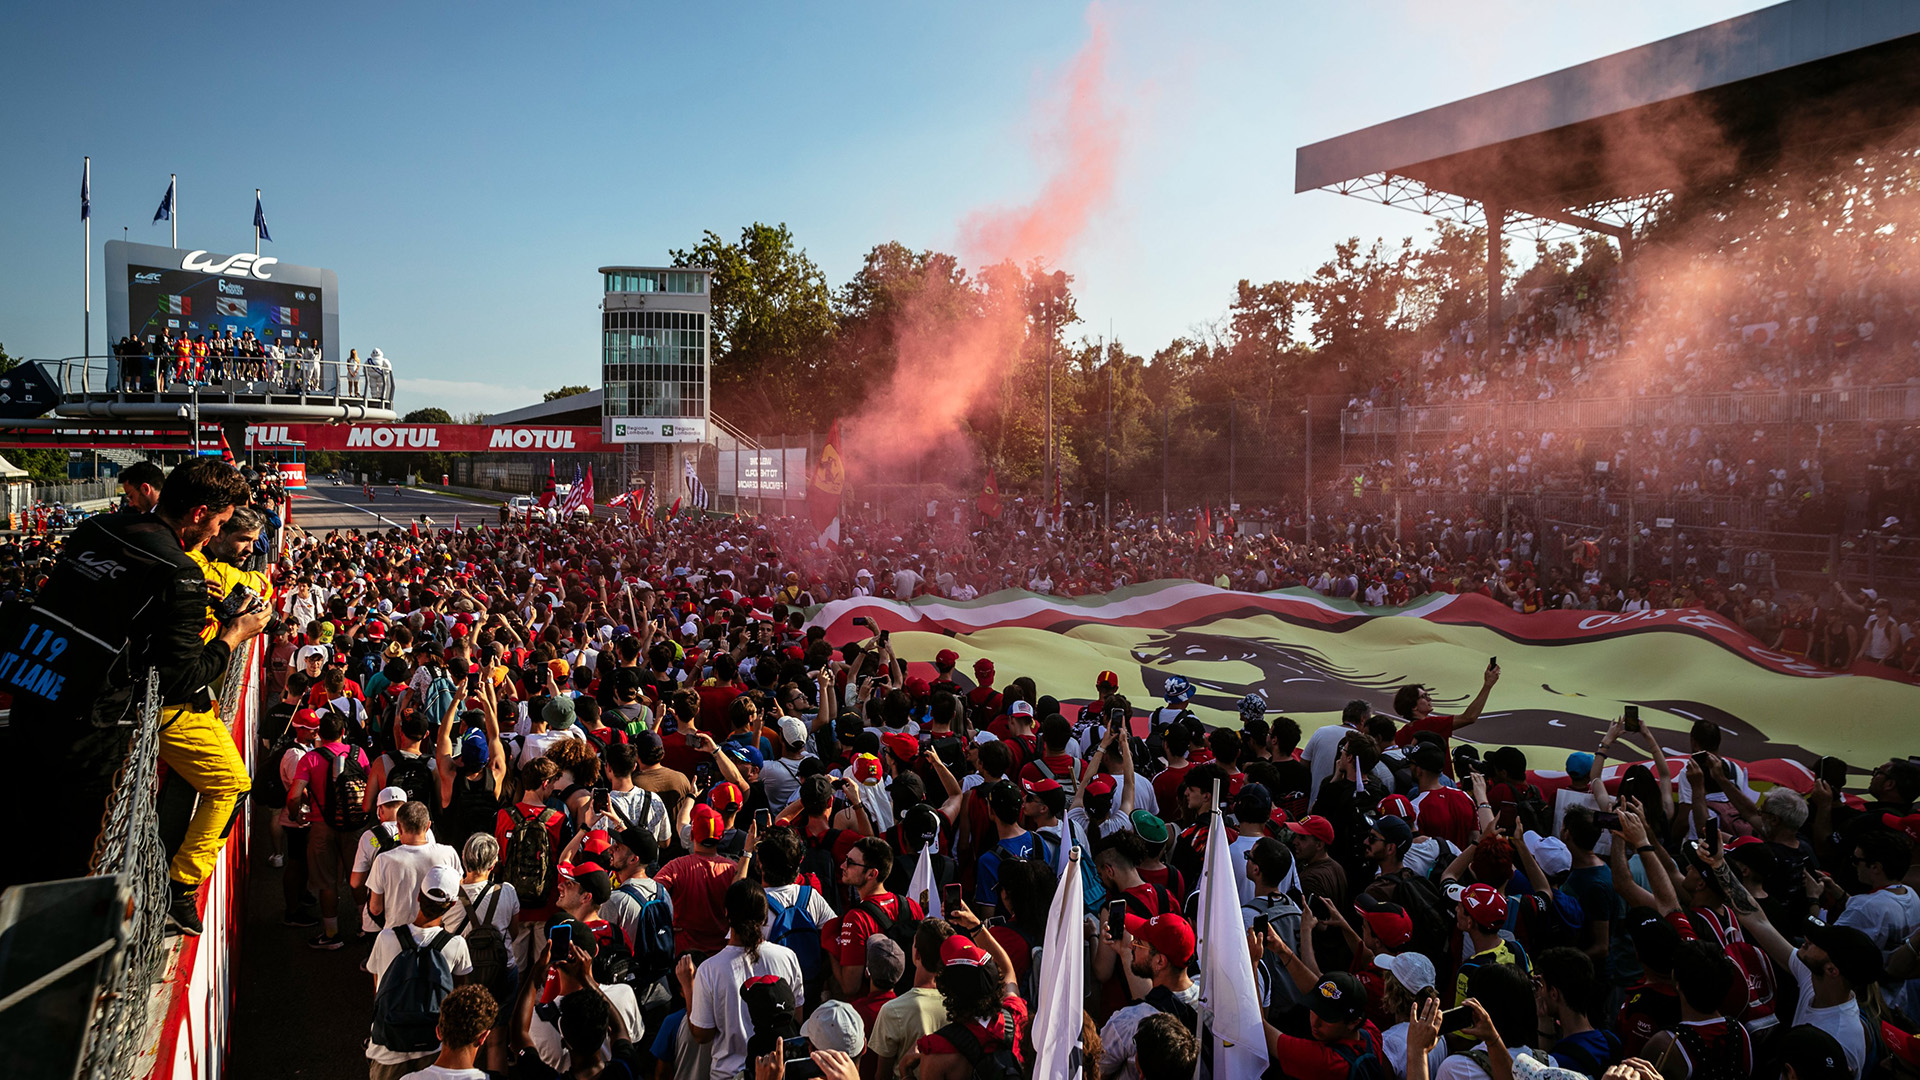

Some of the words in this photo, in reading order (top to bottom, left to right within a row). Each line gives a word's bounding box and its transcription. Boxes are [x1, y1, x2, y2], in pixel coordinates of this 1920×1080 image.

[135, 272, 162, 281] WEC
[181, 250, 278, 280] WEC
[346, 427, 440, 448] MOTUL
[489, 429, 576, 449] MOTUL
[279, 471, 303, 480] OTUL
[77, 551, 127, 580] WEC
[19, 623, 69, 663] 119
[0, 650, 20, 679] IT
[10, 658, 67, 702] LANE
